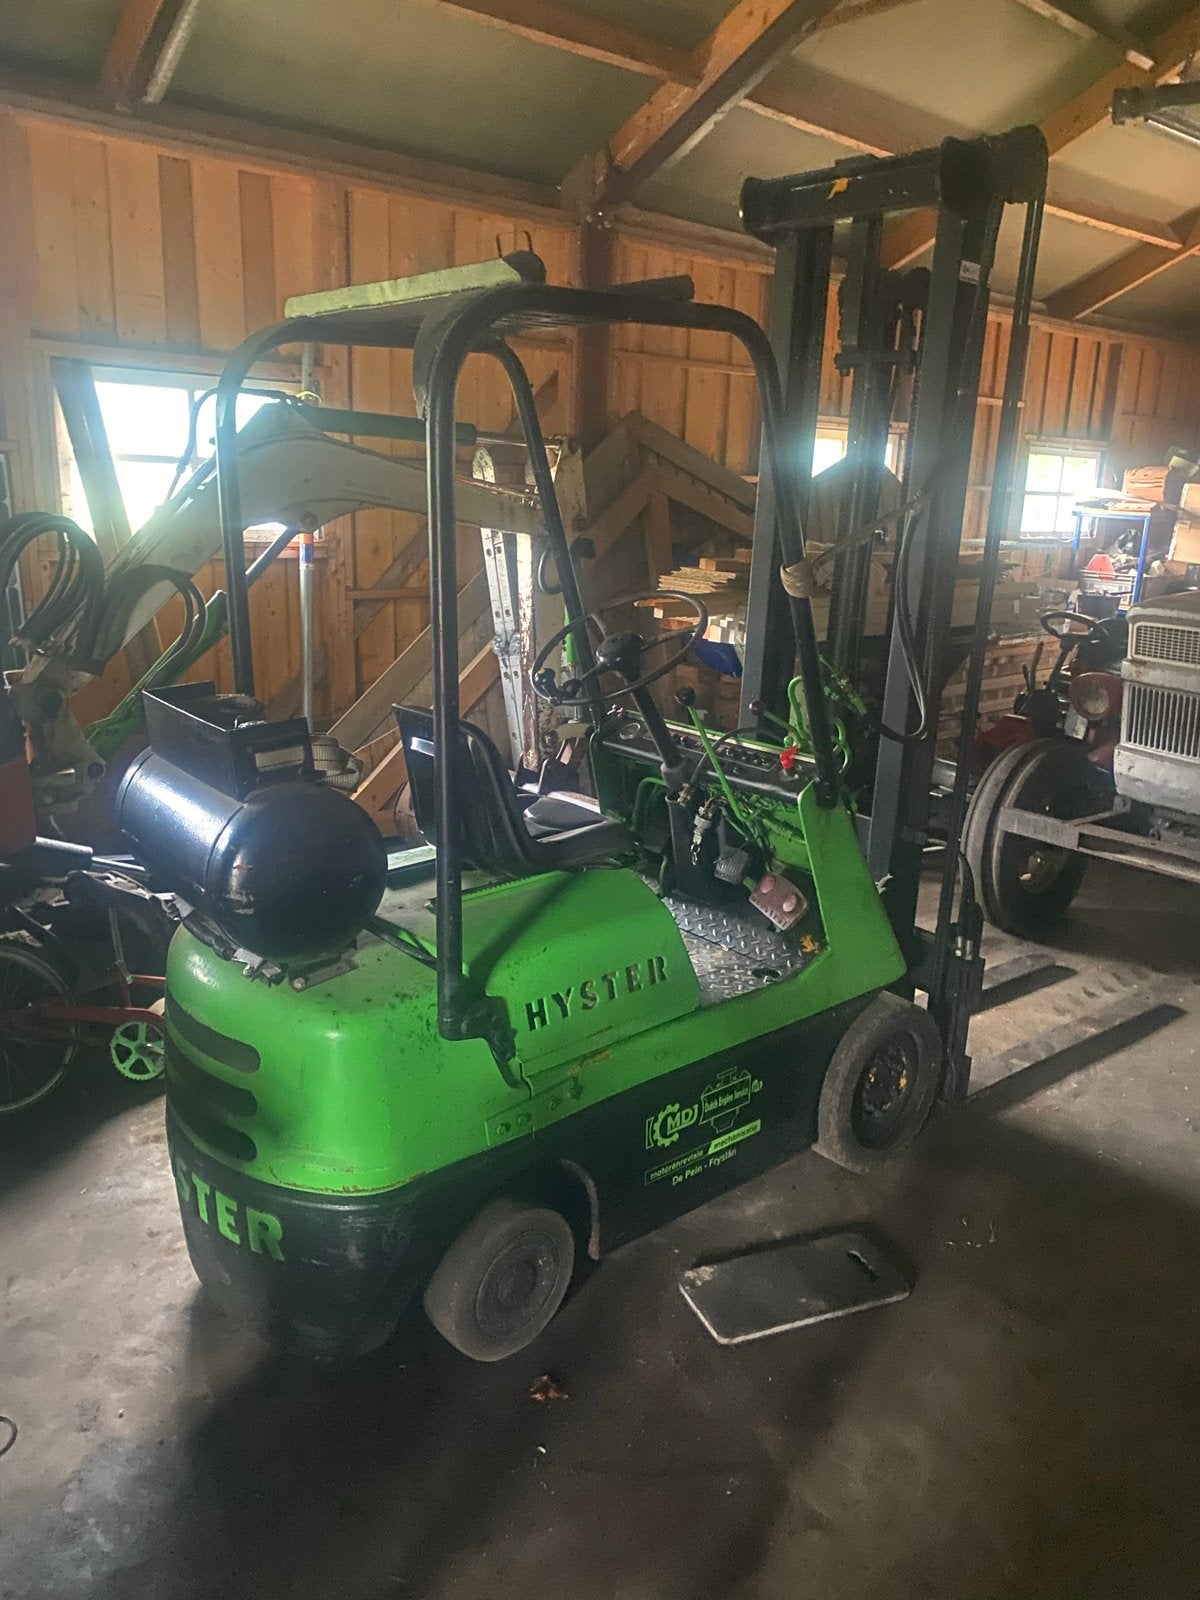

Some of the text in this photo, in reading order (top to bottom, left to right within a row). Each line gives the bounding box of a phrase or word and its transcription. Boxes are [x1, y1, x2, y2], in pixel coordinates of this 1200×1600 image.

[525, 956, 669, 1031] HYSTER
[672, 1174, 683, 1186] De
[685, 1165, 703, 1182] Pein
